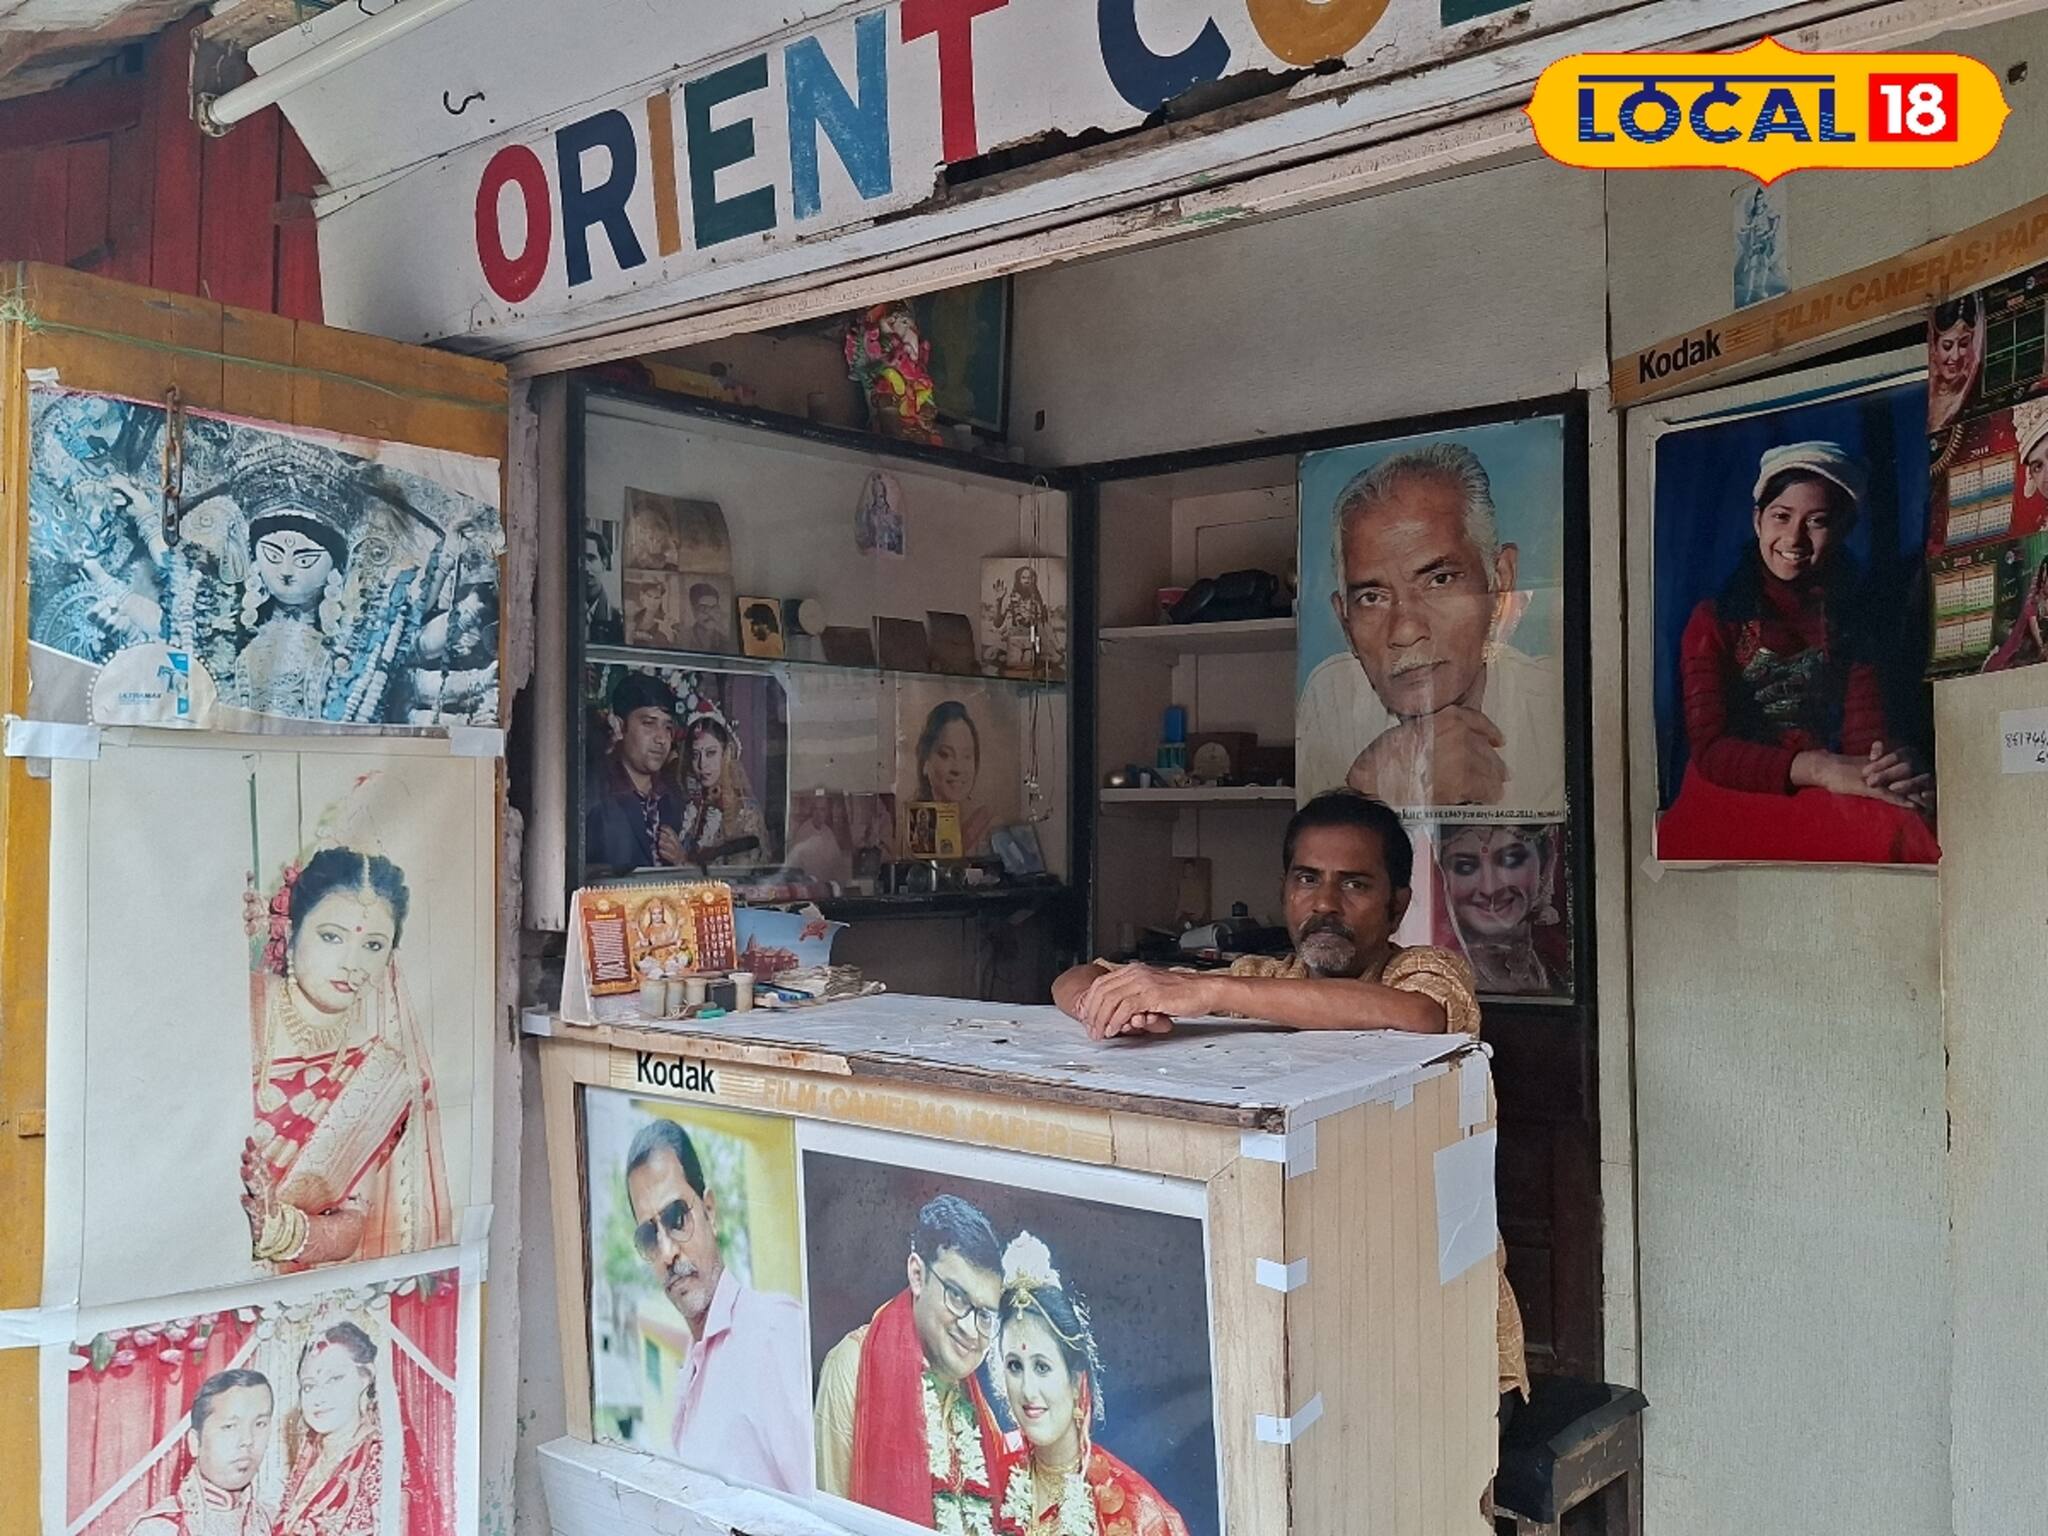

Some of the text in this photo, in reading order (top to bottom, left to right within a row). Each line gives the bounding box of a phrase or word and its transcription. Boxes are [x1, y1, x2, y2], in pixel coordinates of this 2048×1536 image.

[474, 0, 988, 303] ORIENT
[1638, 329, 1722, 384] Kodak
[1774, 294, 1833, 337] FILM
[1845, 239, 1981, 311] CAMERAS
[636, 1050, 716, 1095] Kodak
[763, 1077, 818, 1111] FILM
[828, 1086, 957, 1136] CAMERAS
